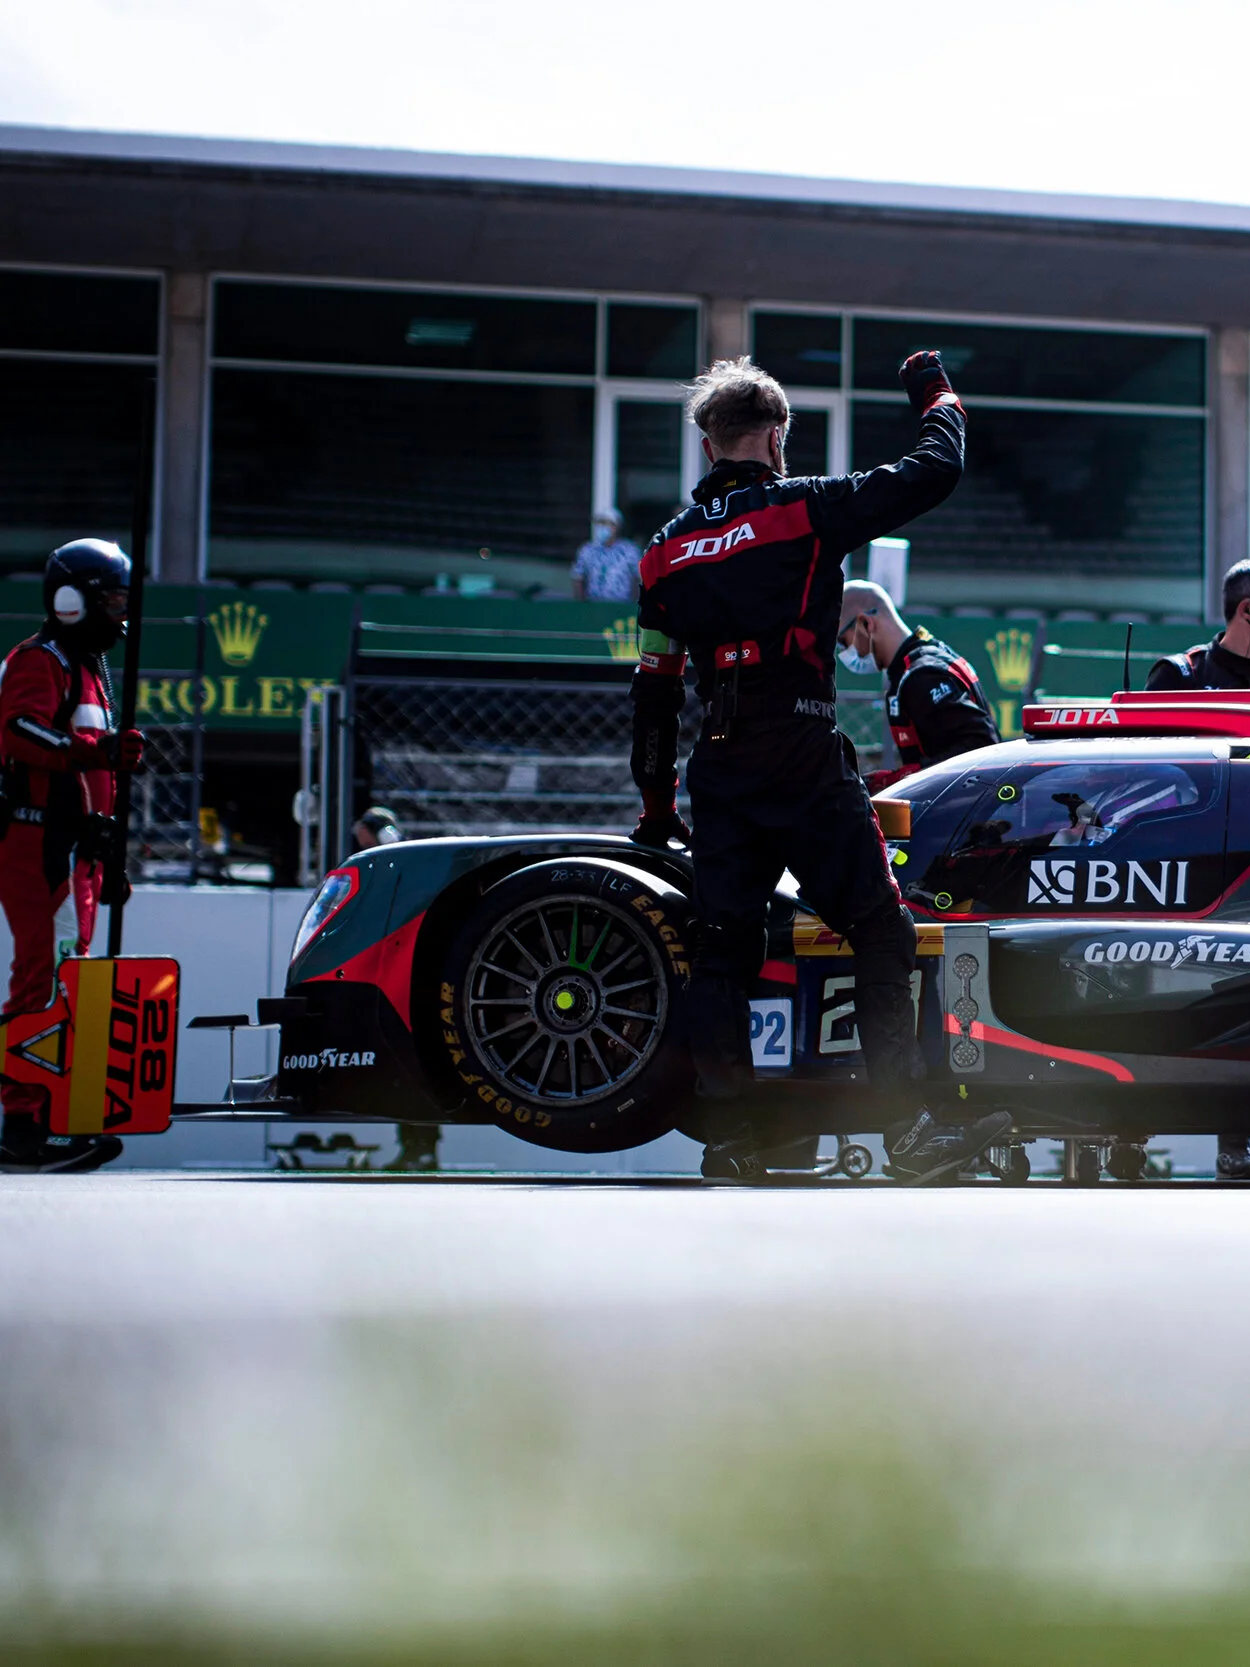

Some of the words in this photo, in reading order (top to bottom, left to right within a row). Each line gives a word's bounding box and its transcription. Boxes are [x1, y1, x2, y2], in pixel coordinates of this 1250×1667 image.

[670, 522, 756, 565] JOTA
[724, 648, 751, 661] spo
[1034, 708, 1120, 725] JOTA
[1085, 860, 1189, 905] BNI
[631, 894, 691, 975] EAGLE
[103, 963, 140, 1130] JOTA
[140, 999, 168, 1092] 28
